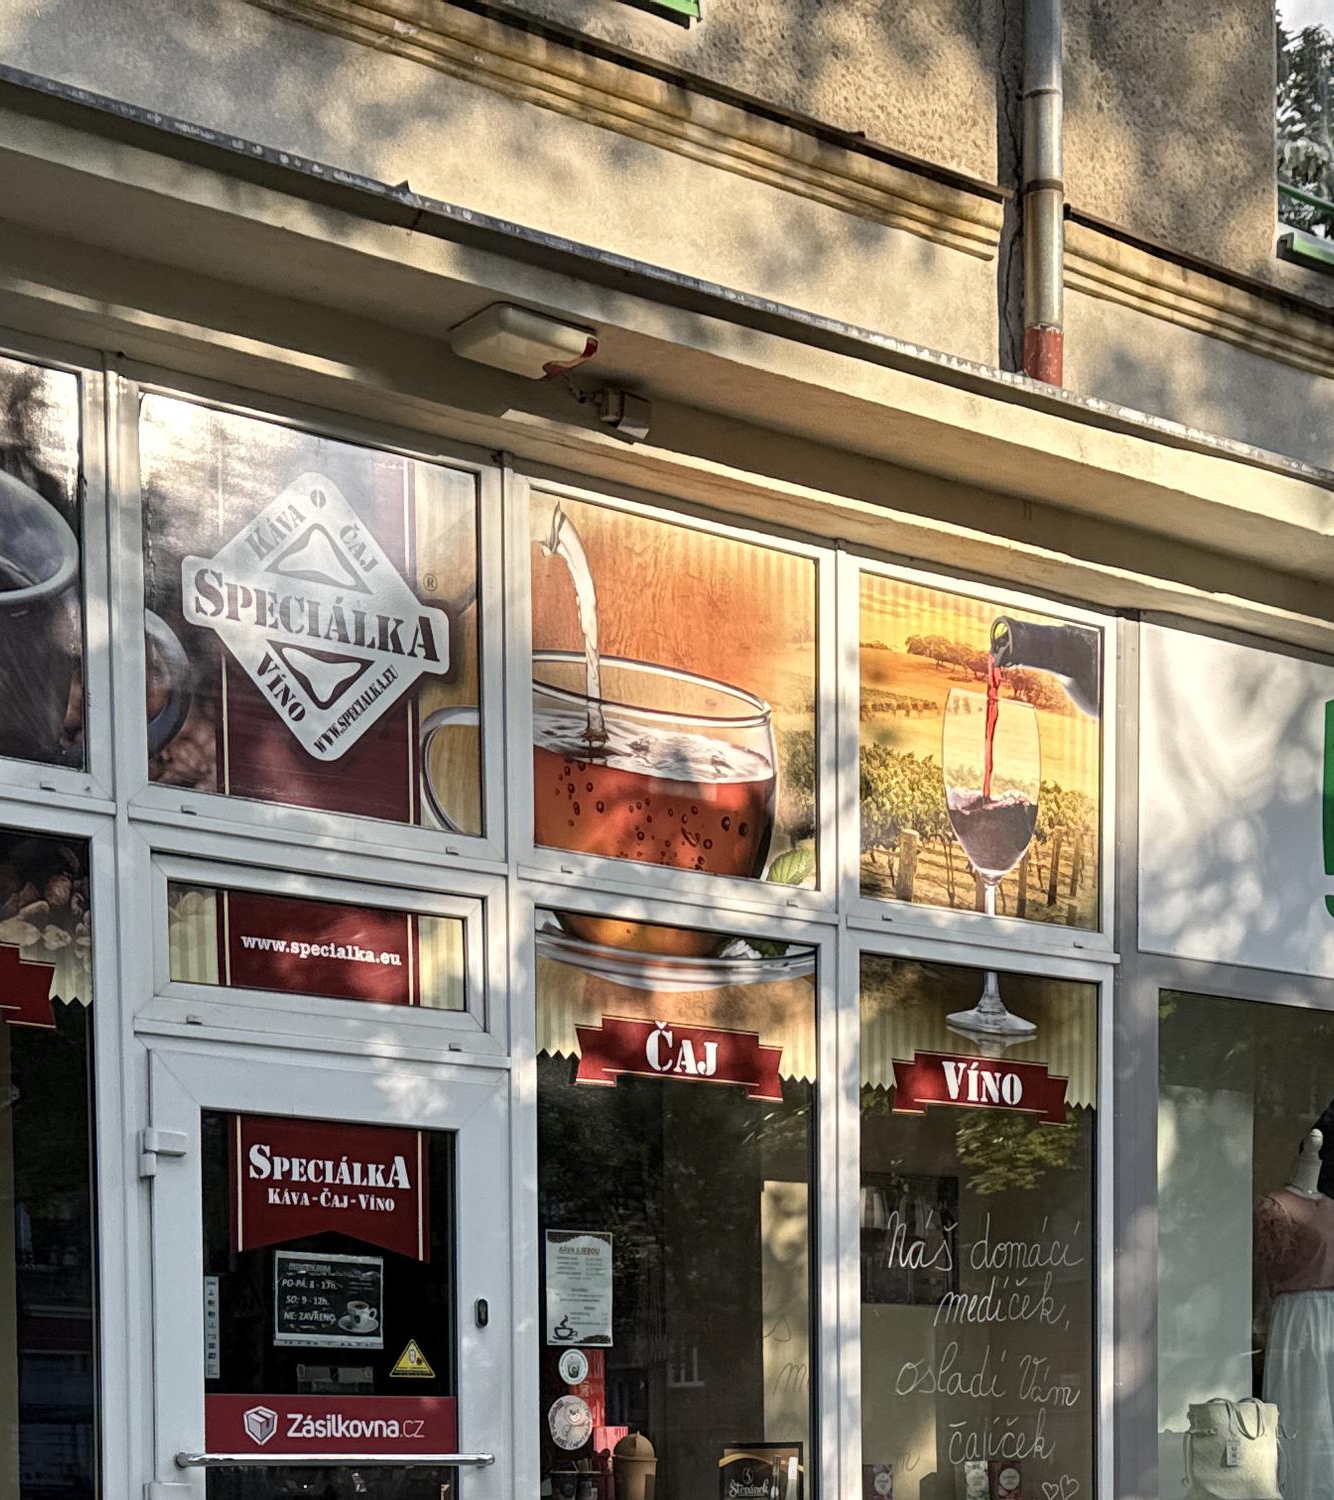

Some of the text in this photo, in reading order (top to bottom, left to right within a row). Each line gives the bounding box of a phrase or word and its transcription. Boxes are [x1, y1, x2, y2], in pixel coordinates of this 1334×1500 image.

[243, 503, 307, 560] KÁVA
[338, 523, 380, 572] ČAJ
[194, 567, 441, 663] SPECIÁLKA
[256, 651, 307, 723] VÍNO
[313, 663, 399, 754] WWW.SPECIALKA.EU
[240, 935, 402, 966] www.specialka.eu
[645, 1020, 720, 1077] ČAJ
[941, 1060, 1024, 1106] VÍNO
[248, 1143, 412, 1190] SPECIÁLKA
[267, 1187, 395, 1213] KÁVA ČAJ VÍNO
[887, 1209, 1086, 1272] Náš domácí
[1018, 1354, 1081, 1407] Vám
[286, 1412, 426, 1439] Zásilkovna.cz
